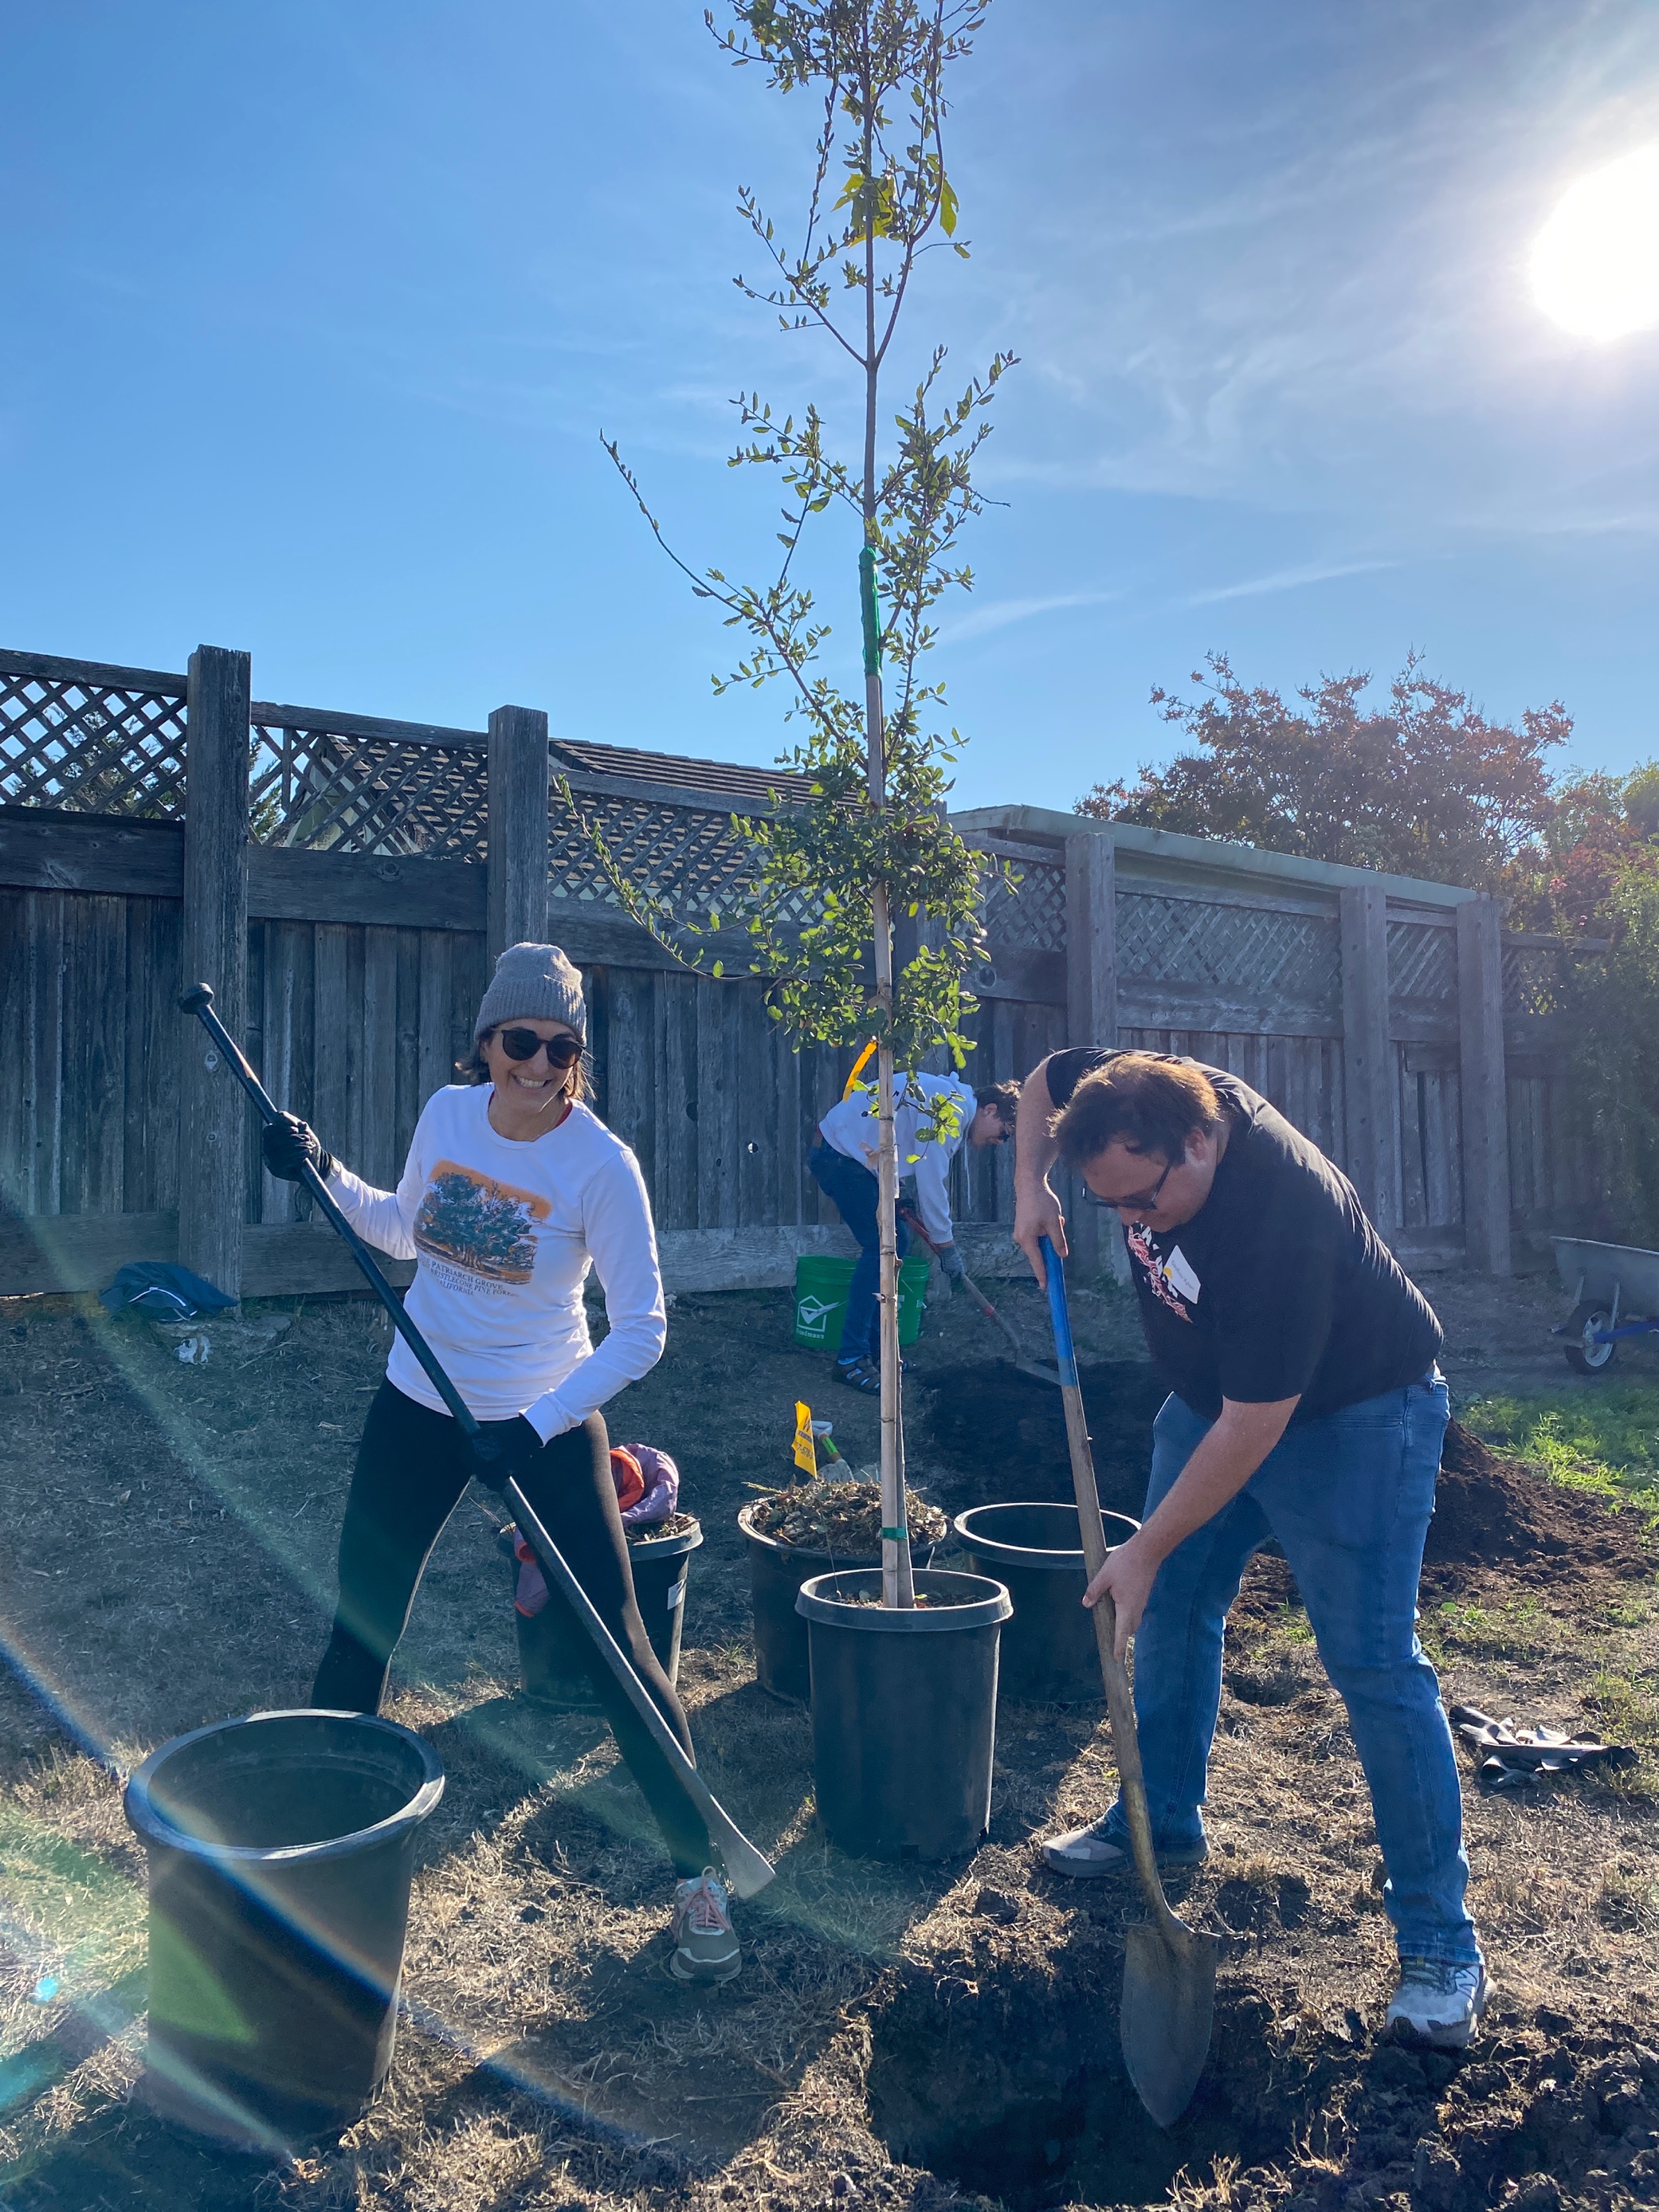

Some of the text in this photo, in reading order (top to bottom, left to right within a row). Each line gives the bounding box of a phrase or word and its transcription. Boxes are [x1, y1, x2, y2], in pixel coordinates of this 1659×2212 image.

[430, 1268, 520, 1297] BRISTLECONE PINE FORE
[432, 1261, 504, 1290] PATRIARCH GROVE
[440, 1280, 473, 1296] ALIFORNIA
